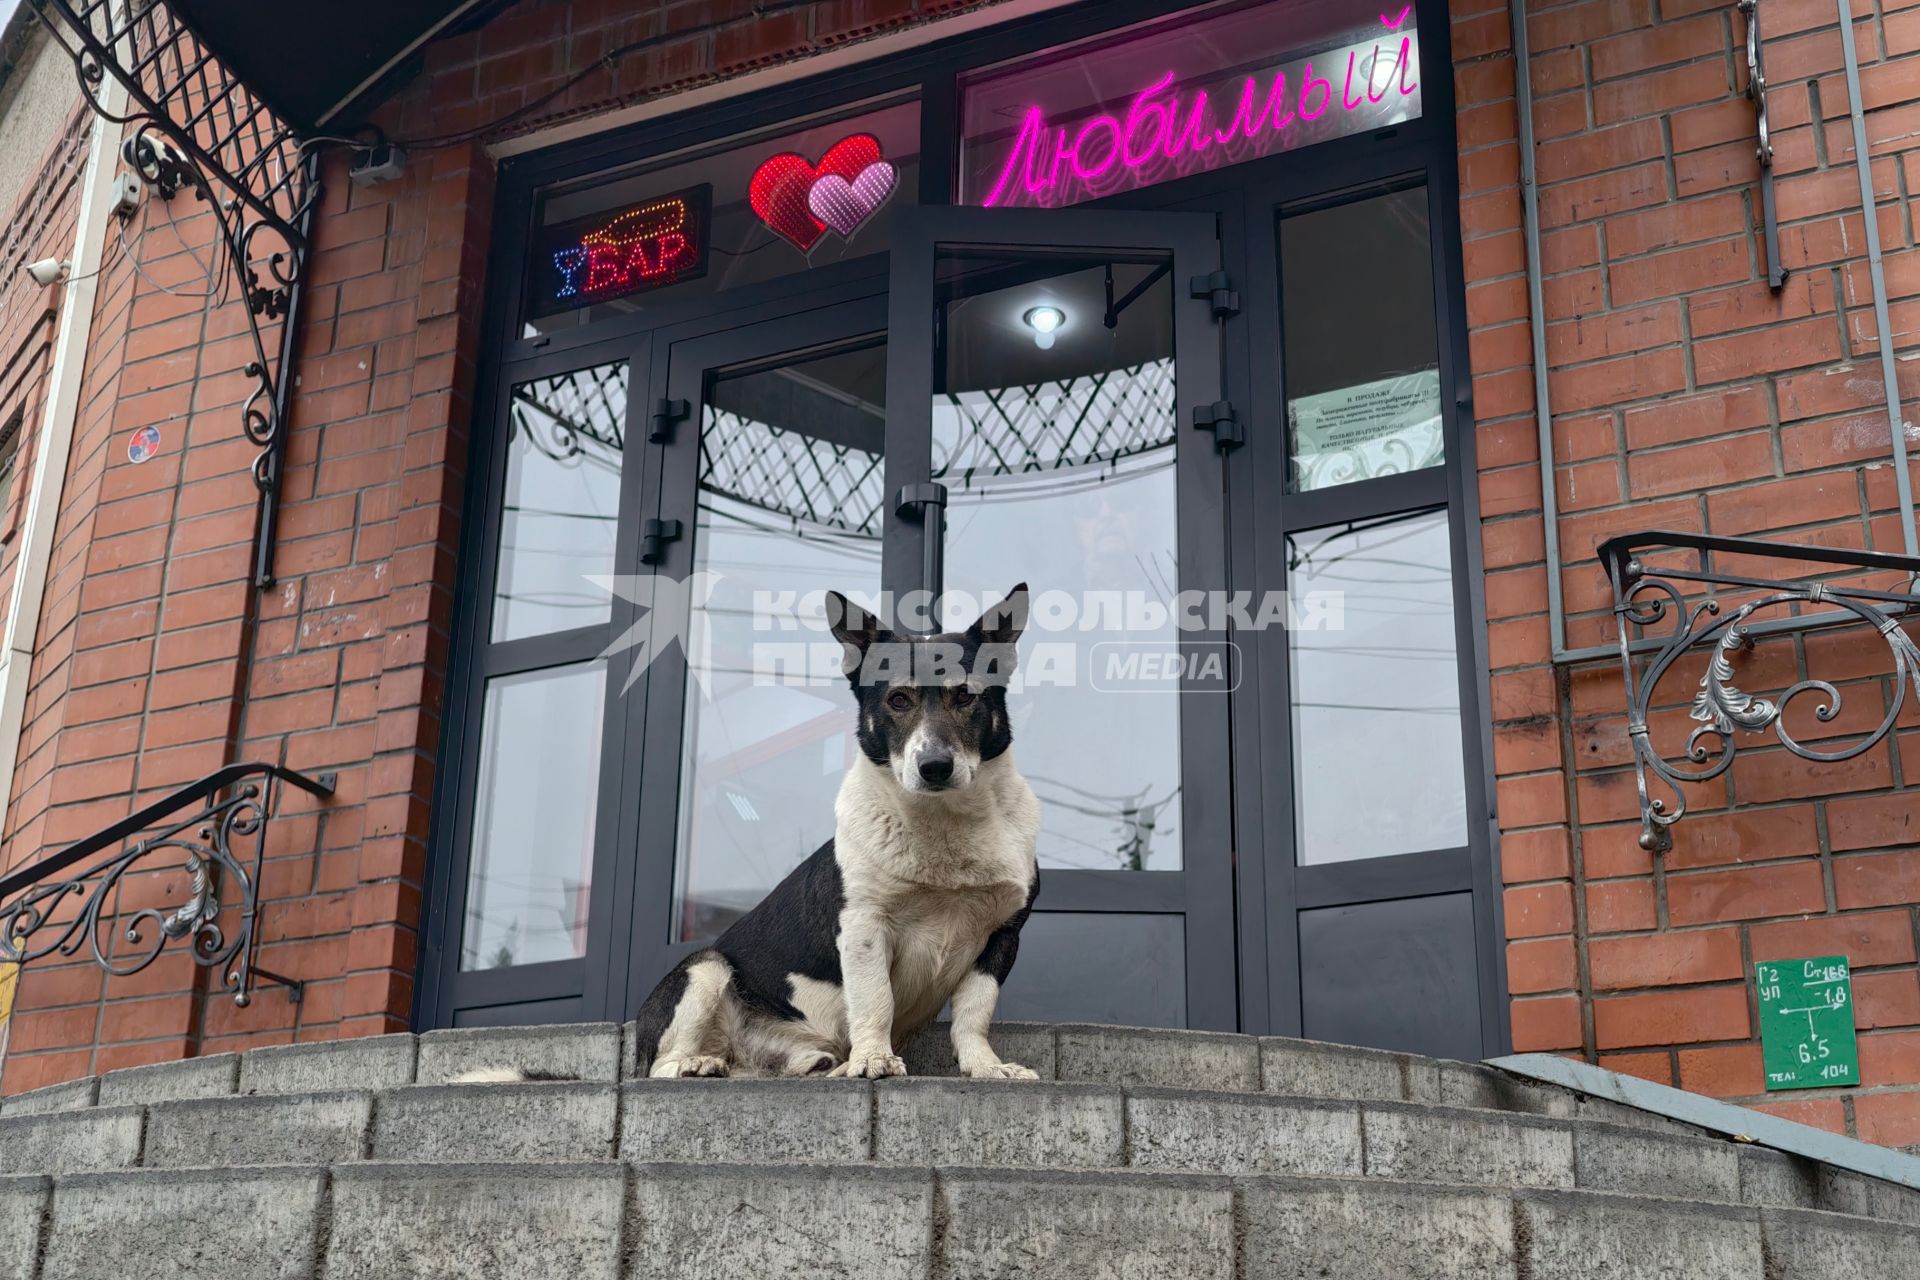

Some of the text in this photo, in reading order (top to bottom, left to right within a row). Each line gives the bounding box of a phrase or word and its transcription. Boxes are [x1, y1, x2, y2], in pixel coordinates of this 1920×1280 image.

[983, 5, 1417, 207] Любимый
[584, 232, 686, 292] БАР
[1798, 1039, 1831, 1064] 6.5
[1820, 1064, 1848, 1079] 104
